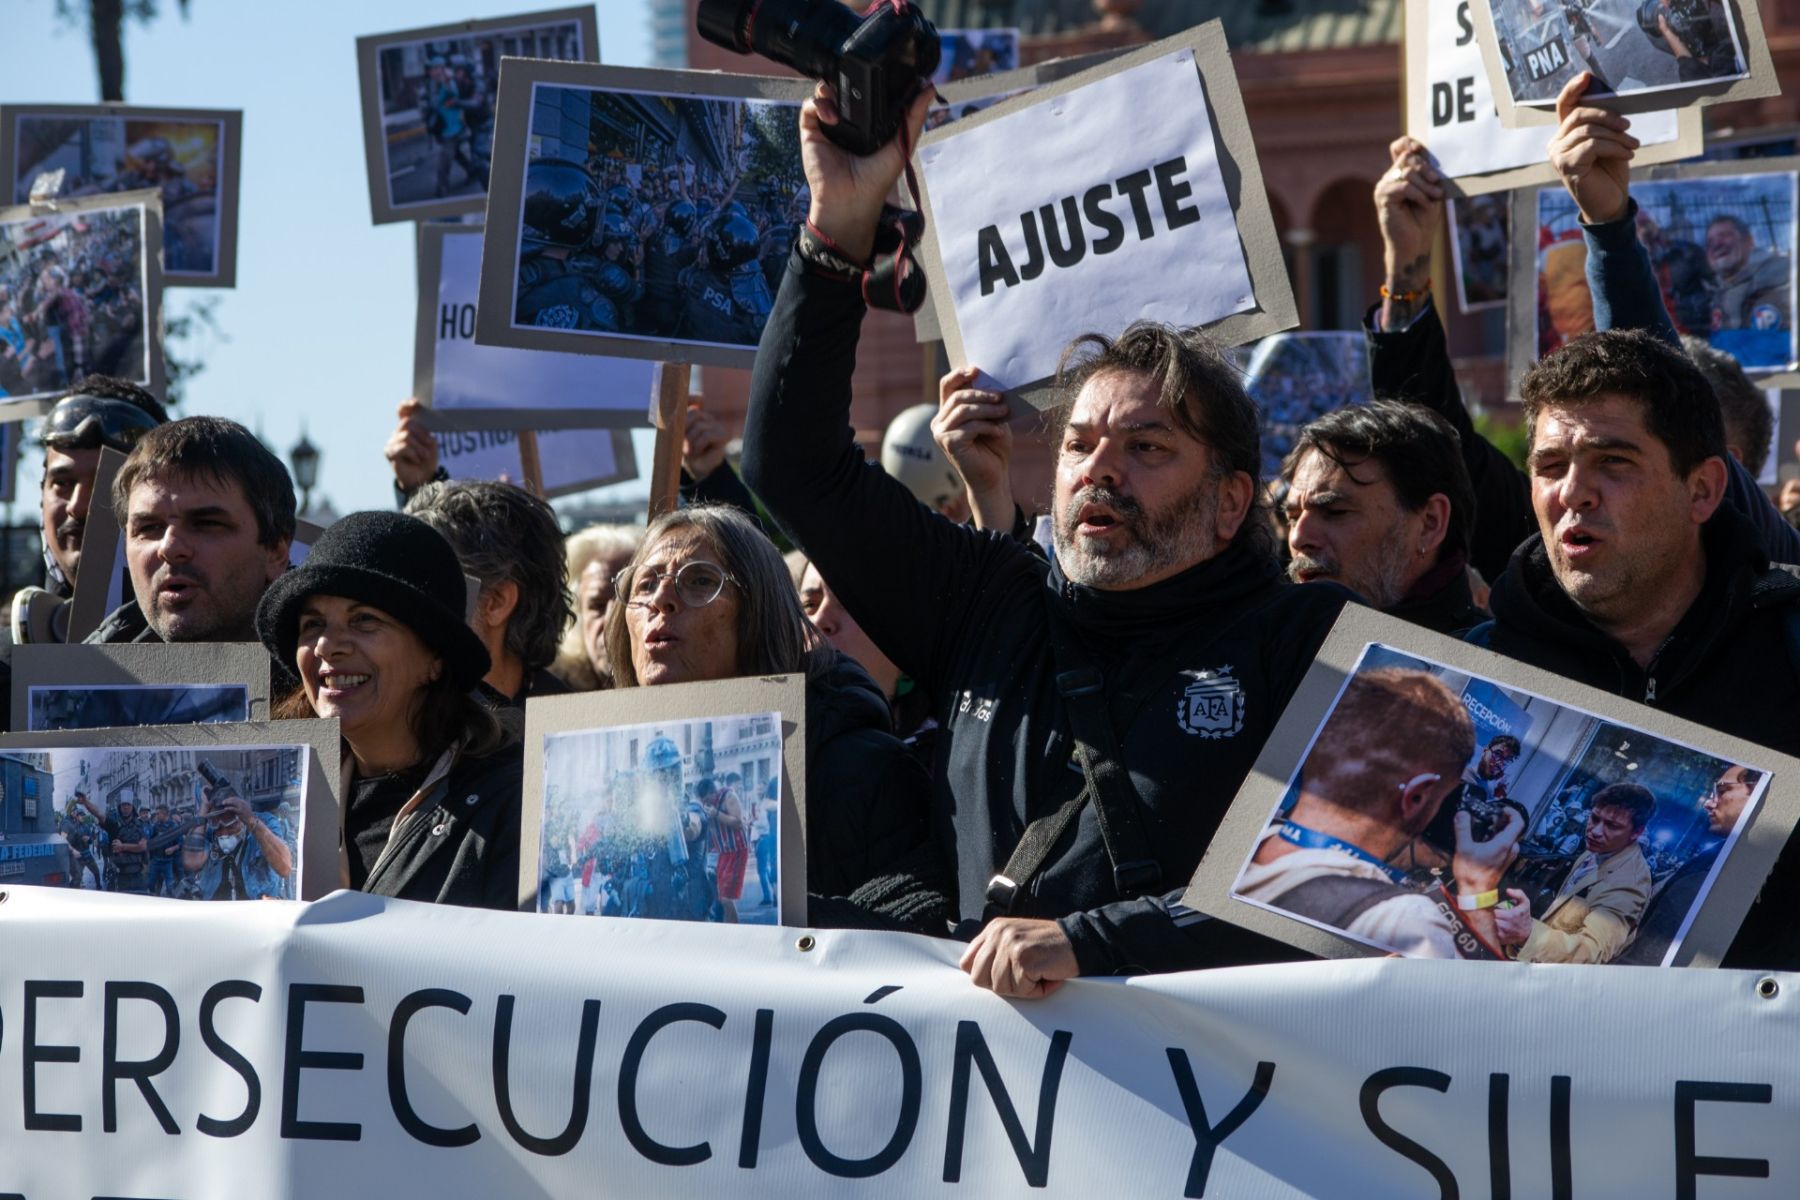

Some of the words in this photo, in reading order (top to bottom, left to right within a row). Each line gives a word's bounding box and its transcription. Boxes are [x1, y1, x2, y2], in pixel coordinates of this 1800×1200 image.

[1527, 40, 1566, 80] PNA
[1432, 76, 1476, 128] DE
[978, 155, 1201, 297] AJUSTE
[703, 285, 733, 316] PSA
[1193, 695, 1229, 722] AFA
[1462, 692, 1512, 733] RECEPCIÓN
[12, 843, 55, 859] FEDERAL
[1438, 901, 1464, 935] EOS
[1458, 932, 1478, 952] 6D
[0, 977, 1072, 1189] ERSECUCIÓN
[1165, 1046, 1276, 1199] Y
